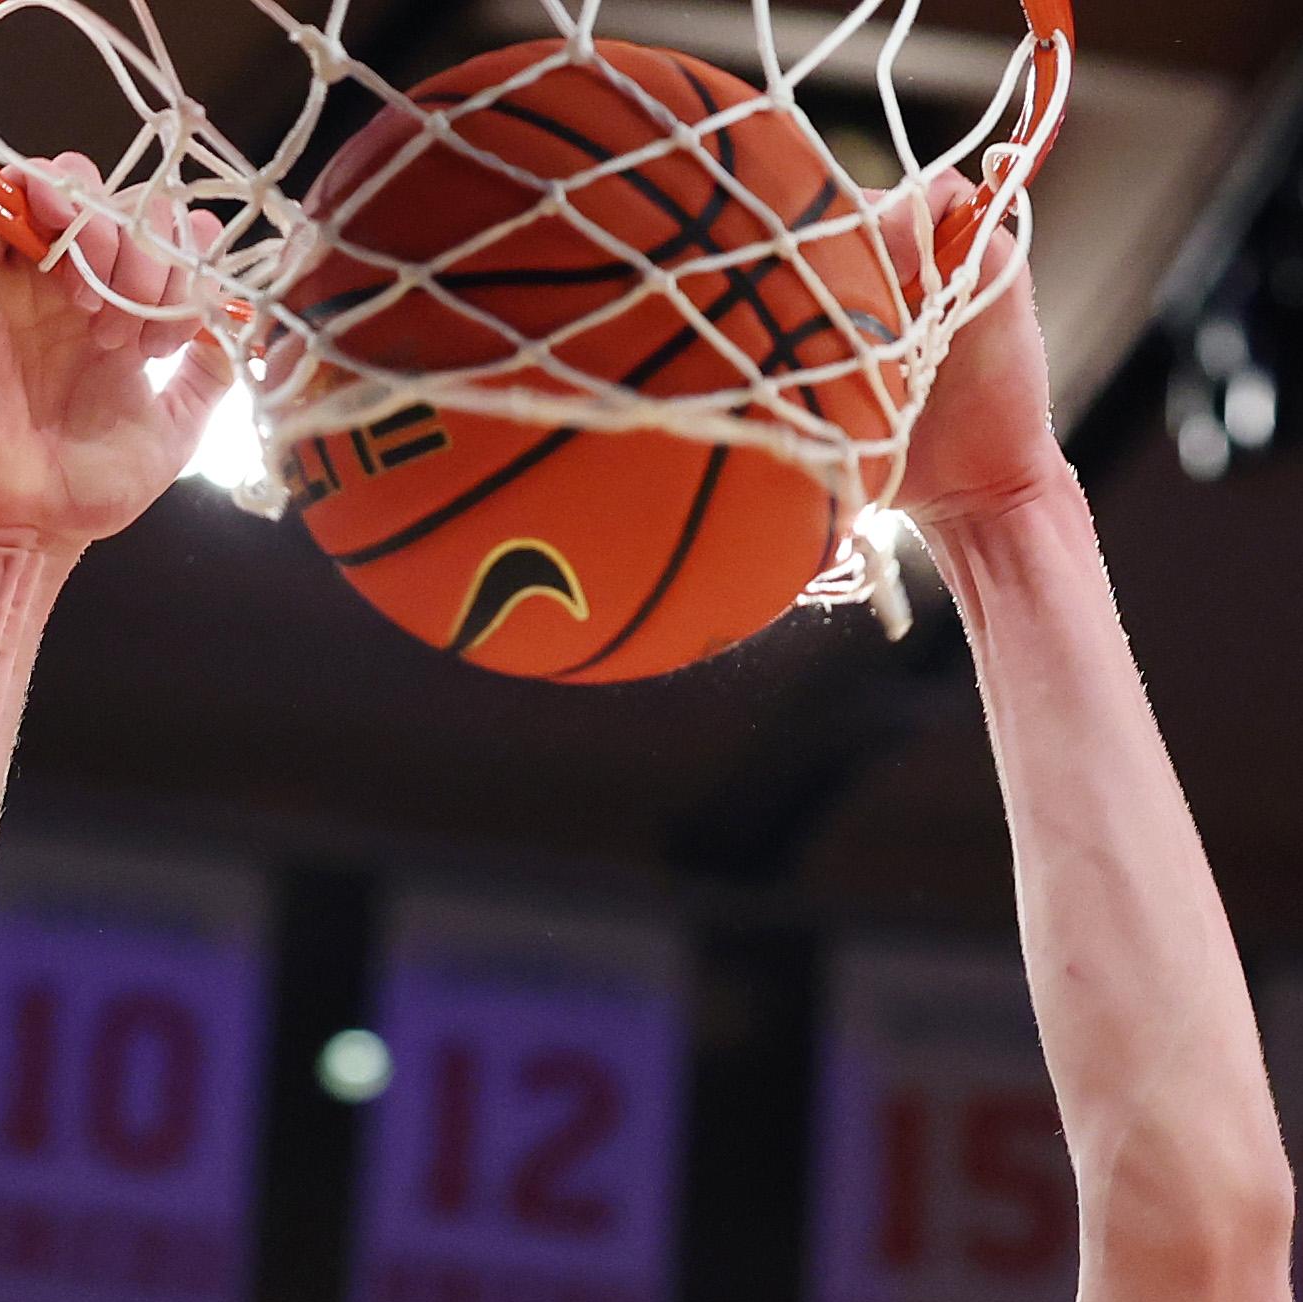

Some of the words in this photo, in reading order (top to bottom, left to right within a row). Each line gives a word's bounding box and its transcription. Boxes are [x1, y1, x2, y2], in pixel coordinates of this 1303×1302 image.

[1, 978, 204, 1178] 10
[423, 1040, 624, 1238] 12
[874, 1085, 1080, 1278] 15
